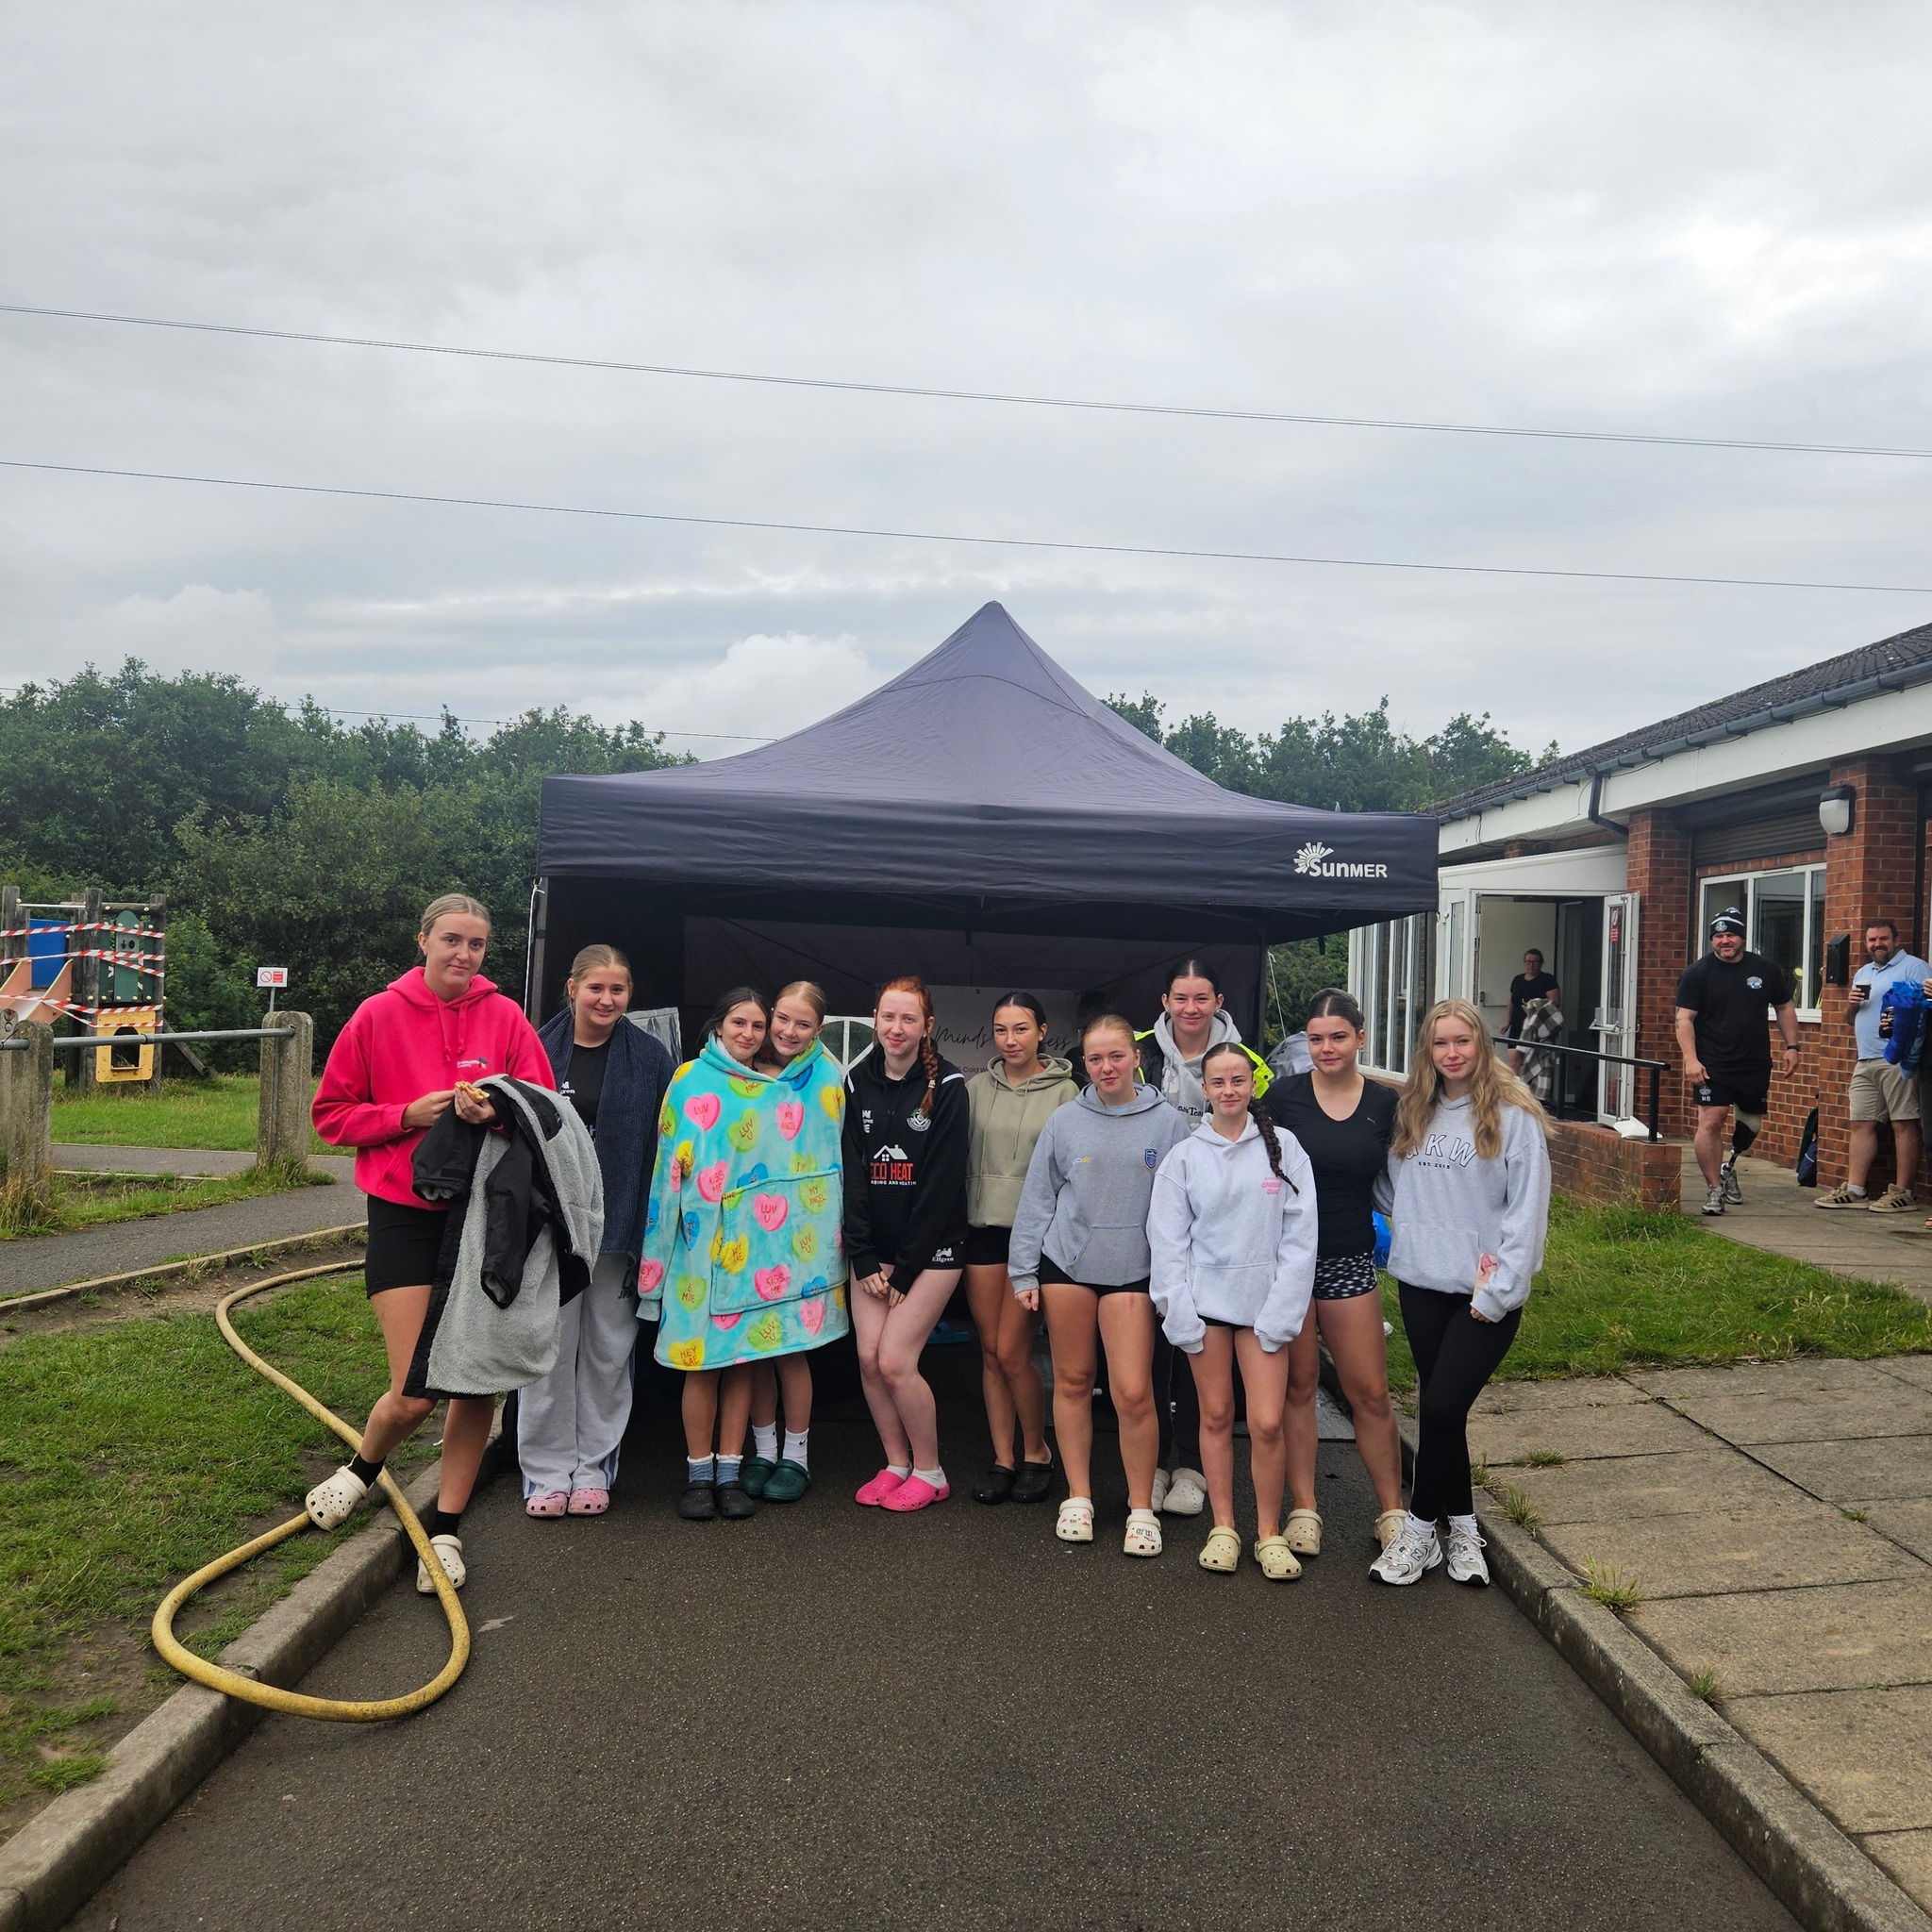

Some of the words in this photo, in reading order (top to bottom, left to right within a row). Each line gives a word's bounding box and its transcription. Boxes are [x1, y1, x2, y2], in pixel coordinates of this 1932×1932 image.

[935, 1025, 991, 1050] Minds
[1046, 1037, 1072, 1051] ess
[693, 1103, 709, 1115] LUV
[699, 1114, 707, 1124] U
[784, 1111, 794, 1121] MY
[739, 1119, 754, 1139] LUV
[746, 1131, 754, 1141] U
[890, 1162, 914, 1181] HEAT
[708, 1170, 724, 1186] KISS
[808, 1185, 819, 1195] MY
[760, 1203, 778, 1214] LUV
[764, 1213, 772, 1224] U
[799, 1232, 812, 1250] LUV
[765, 1272, 785, 1286] KISS
[770, 1285, 782, 1295] ME
[758, 1321, 775, 1340] LUV
[768, 1332, 776, 1342] U
[679, 1345, 697, 1359] HEY
